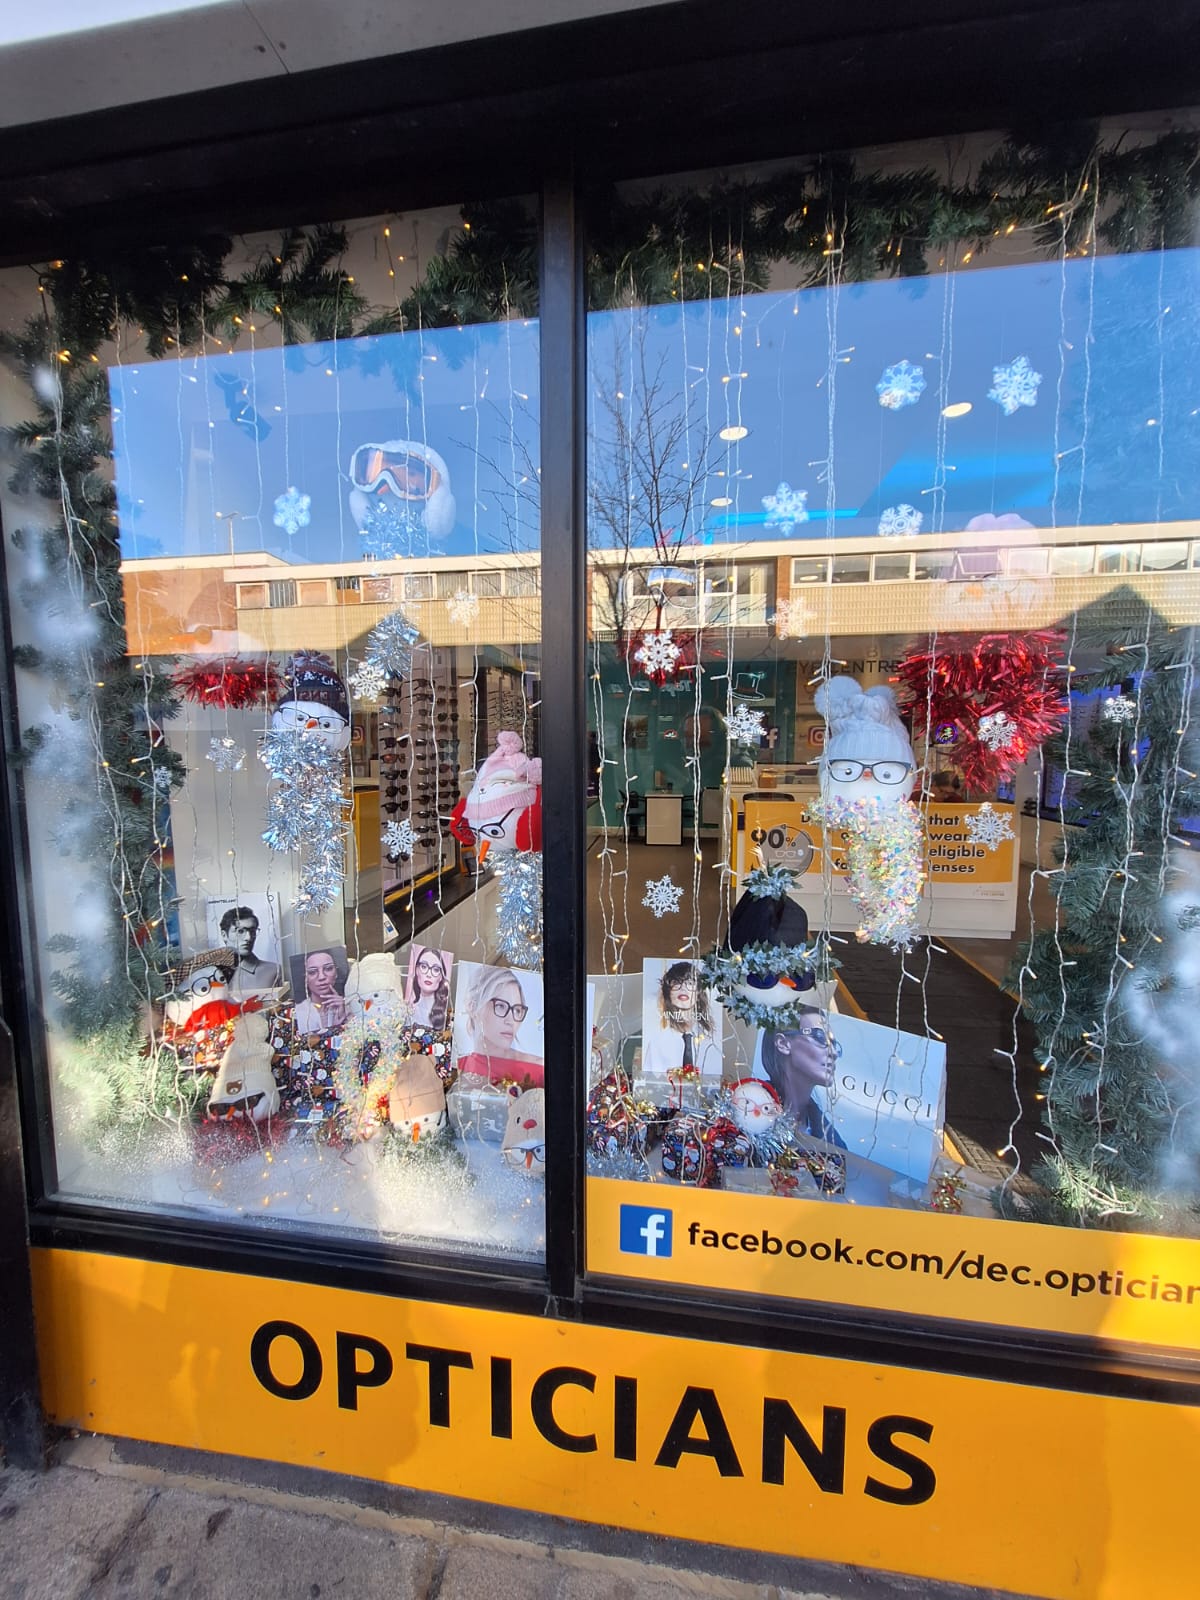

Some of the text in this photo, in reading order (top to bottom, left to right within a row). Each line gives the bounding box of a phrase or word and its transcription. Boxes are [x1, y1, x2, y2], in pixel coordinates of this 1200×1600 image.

[929, 813, 960, 826] that
[750, 828, 797, 849] 90%
[929, 844, 985, 860] eligible
[928, 859, 975, 873] lenses
[841, 1075, 932, 1119] GUCCI
[249, 1319, 937, 1506] OPTICIANS
